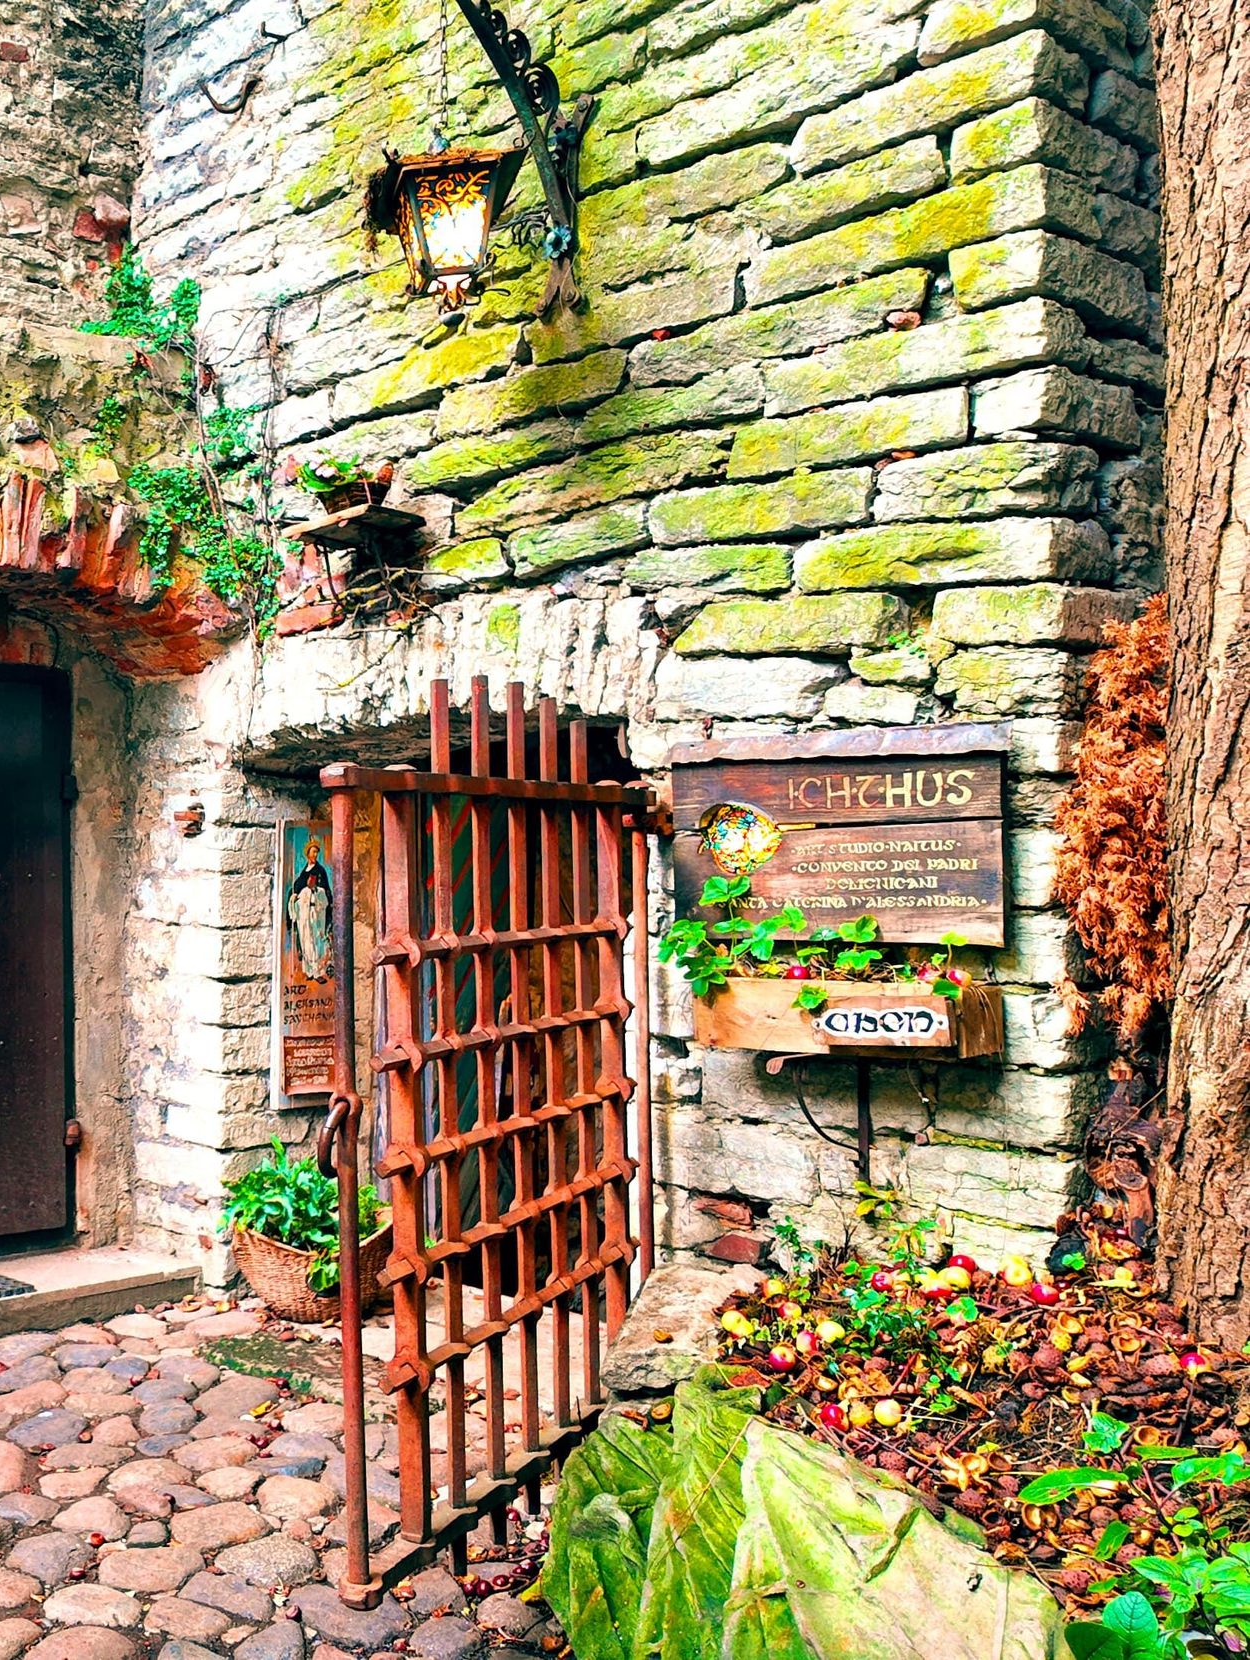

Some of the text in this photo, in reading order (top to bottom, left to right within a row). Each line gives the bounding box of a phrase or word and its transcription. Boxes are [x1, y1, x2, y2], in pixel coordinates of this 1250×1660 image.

[795, 843, 825, 857] ART
[796, 860, 888, 874] CONVENTO
[927, 857, 979, 872] PADRI
[283, 984, 307, 996] ART
[283, 997, 334, 1012] ALEKSAND
